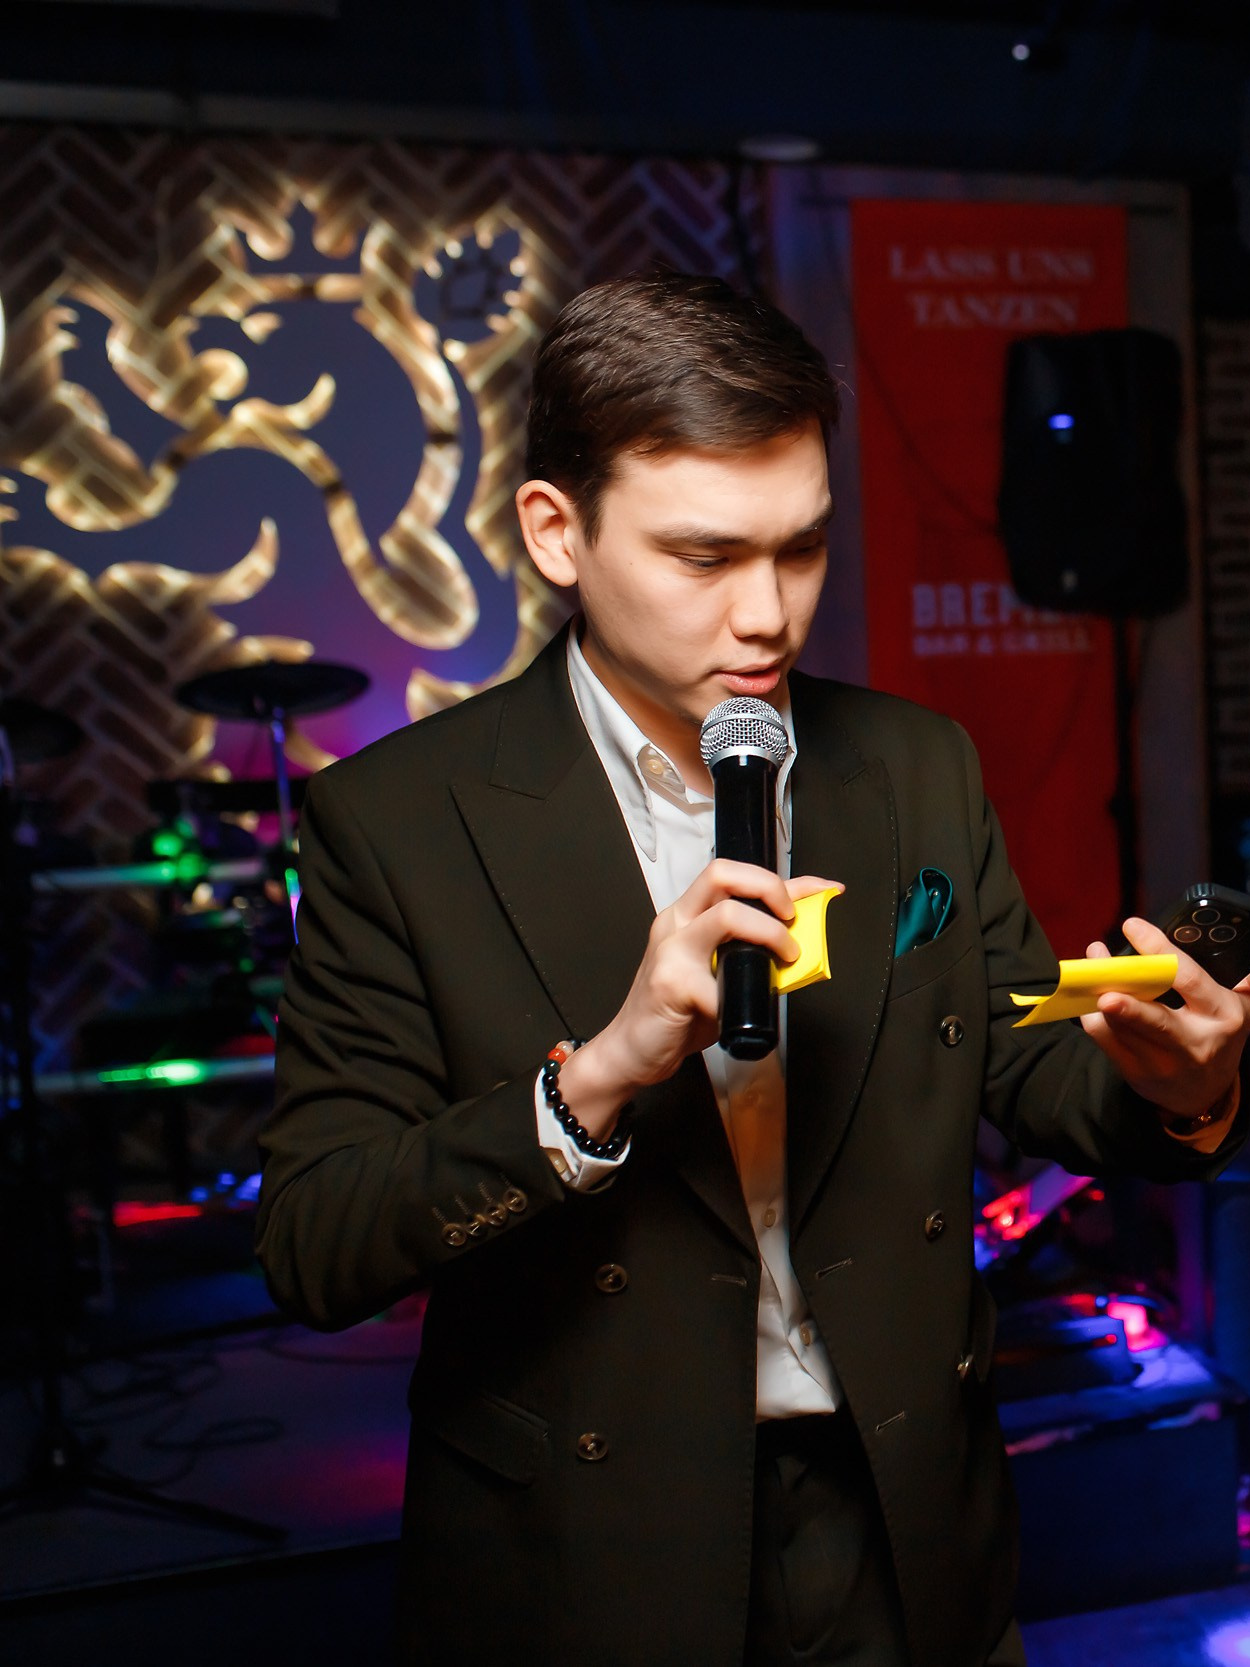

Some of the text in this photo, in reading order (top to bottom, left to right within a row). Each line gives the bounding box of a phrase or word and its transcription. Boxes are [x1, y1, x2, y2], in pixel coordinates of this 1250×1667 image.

[888, 246, 1094, 283] LASS UNS
[906, 291, 1079, 328] TANZEN
